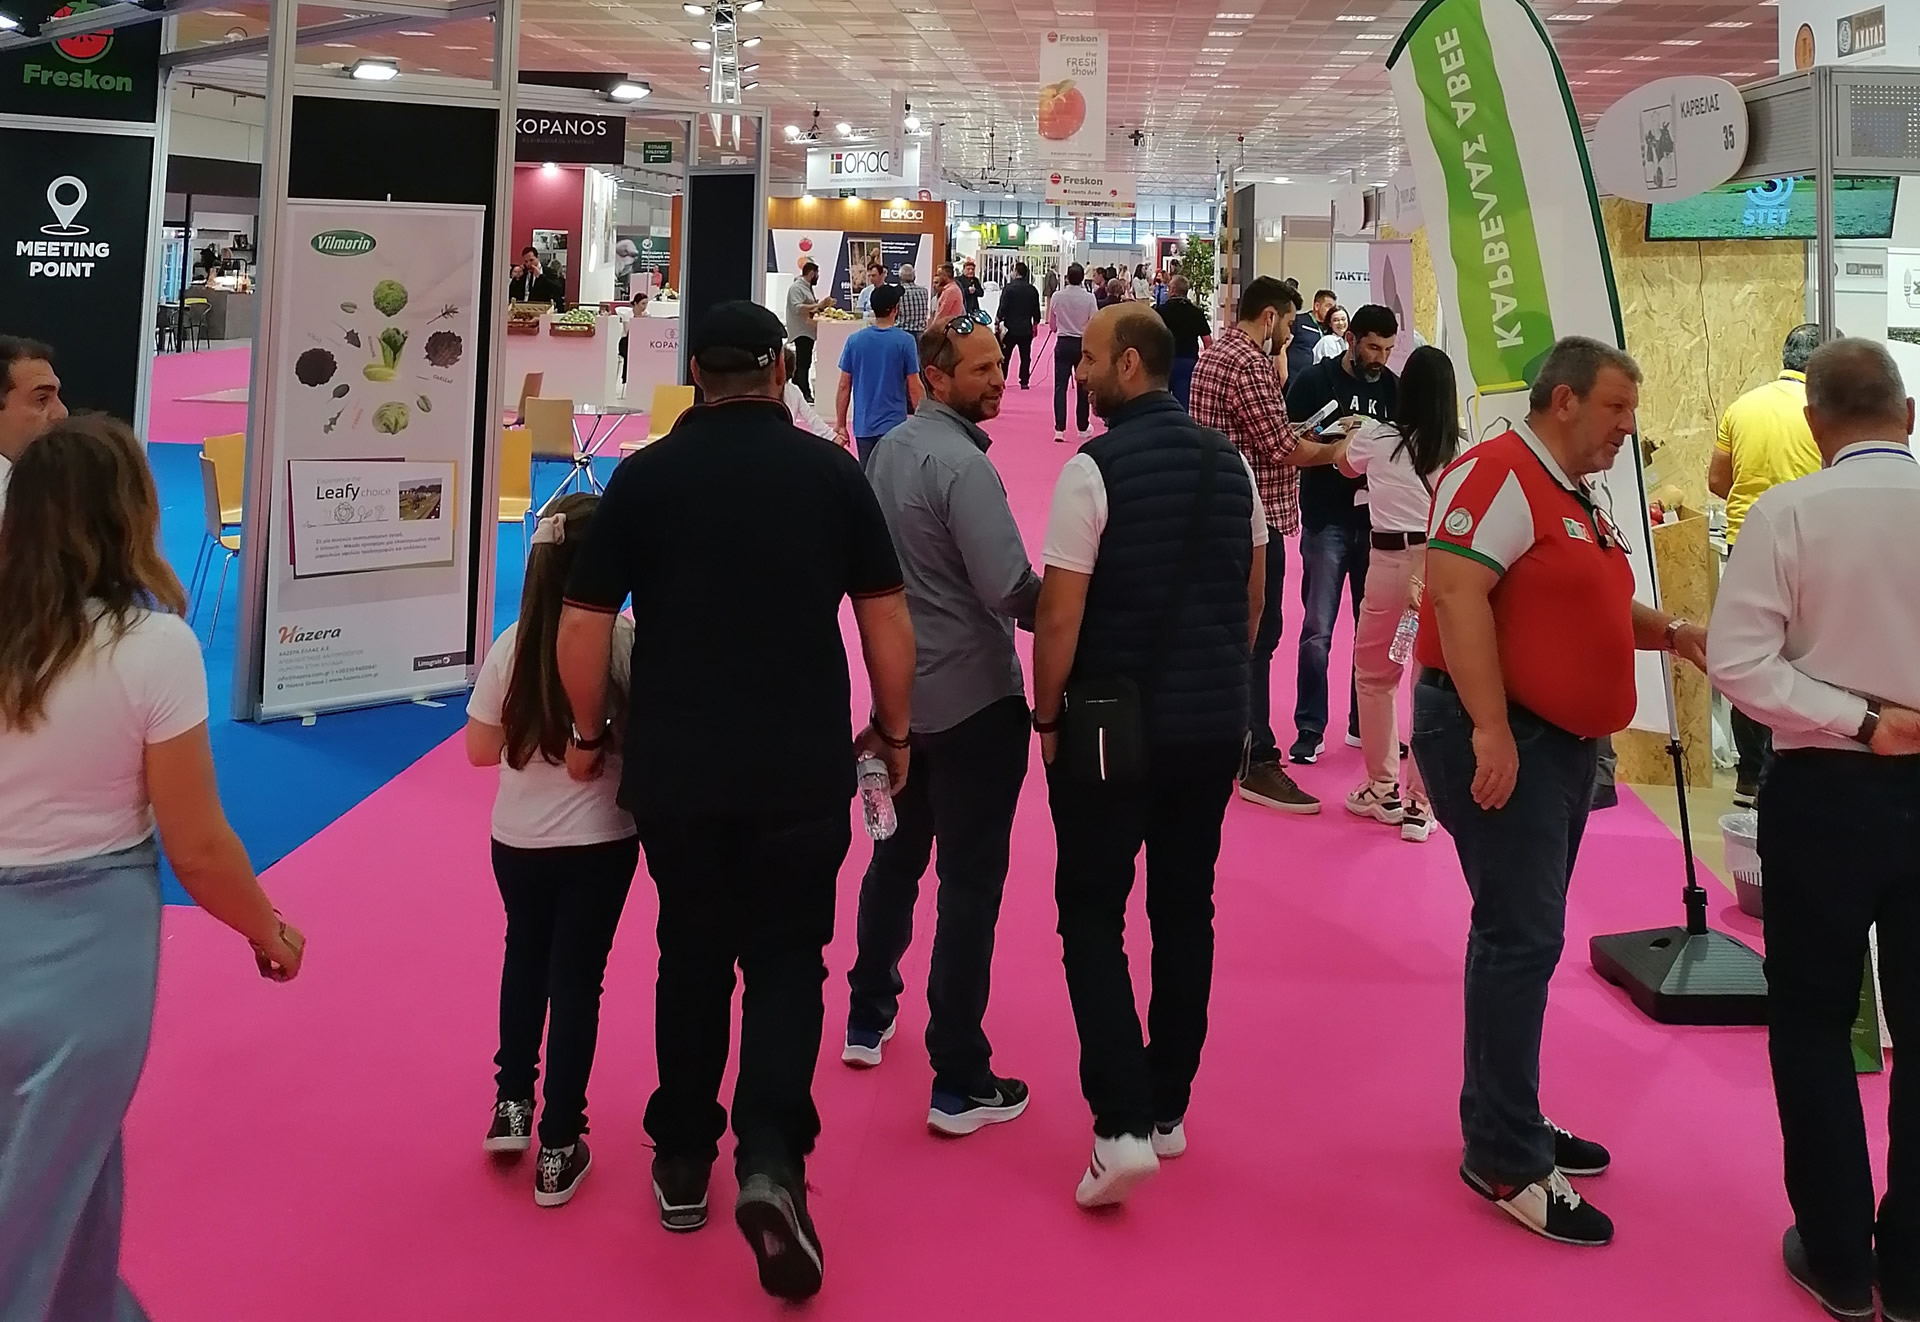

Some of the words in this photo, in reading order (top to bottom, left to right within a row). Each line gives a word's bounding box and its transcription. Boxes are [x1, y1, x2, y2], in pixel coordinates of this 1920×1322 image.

[1060, 33, 1098, 43] Freskon
[1066, 57, 1097, 67] FRESH
[23, 64, 132, 92] Freskon
[1071, 66, 1097, 76] show!
[1680, 93, 1720, 118] ΚΑΡΒΕΛΑΣ
[515, 118, 607, 136] KOPANOS
[1723, 125, 1735, 150] 35
[1063, 175, 1103, 186] Freskon
[1743, 208, 1790, 225] STET
[16, 241, 110, 258] MEETING
[318, 236, 371, 250] Vilmorin
[29, 262, 95, 278] POINT
[316, 483, 360, 501] Leafy
[361, 487, 391, 497] choice
[278, 625, 342, 644] Hazera
